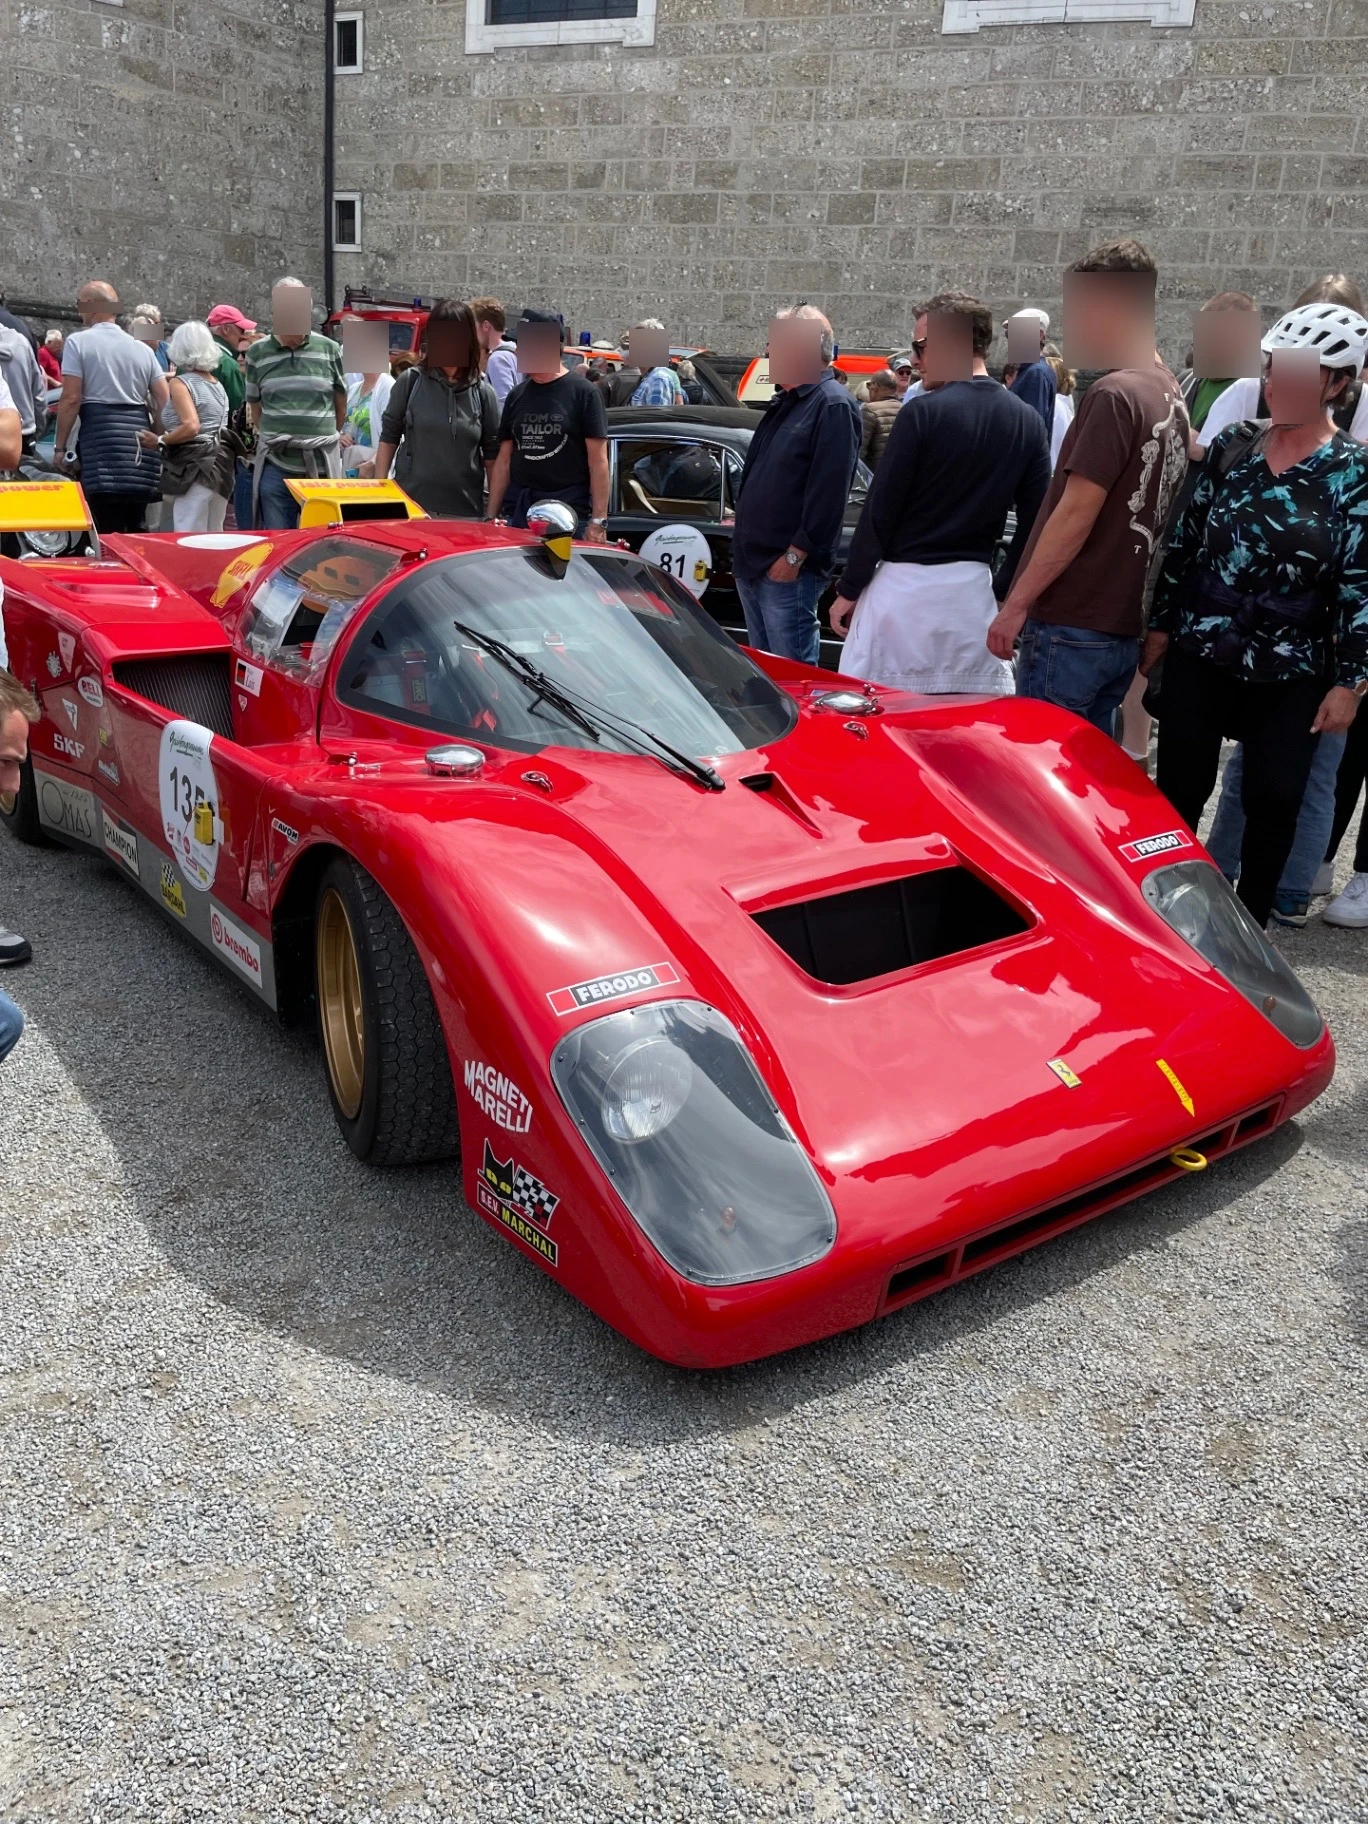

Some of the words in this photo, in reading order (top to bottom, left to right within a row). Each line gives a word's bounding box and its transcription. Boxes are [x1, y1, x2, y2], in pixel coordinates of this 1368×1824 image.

[520, 423, 562, 435] TAILOR
[523, 414, 548, 422] TOM
[660, 552, 686, 579] 81
[81, 679, 101, 698] BELL
[53, 732, 86, 759] SKF
[41, 780, 92, 839] OMAS
[104, 821, 138, 864] CHAMPION
[278, 822, 298, 840] AVON
[1135, 835, 1179, 854] FERODO
[223, 926, 260, 974] brembo
[575, 971, 652, 1003] FERODO
[464, 1059, 533, 1126] MAGNETI
[464, 1072, 533, 1133] MARELLI
[480, 1188, 500, 1214] S.E.V.
[501, 1208, 555, 1261] MARCHAL
